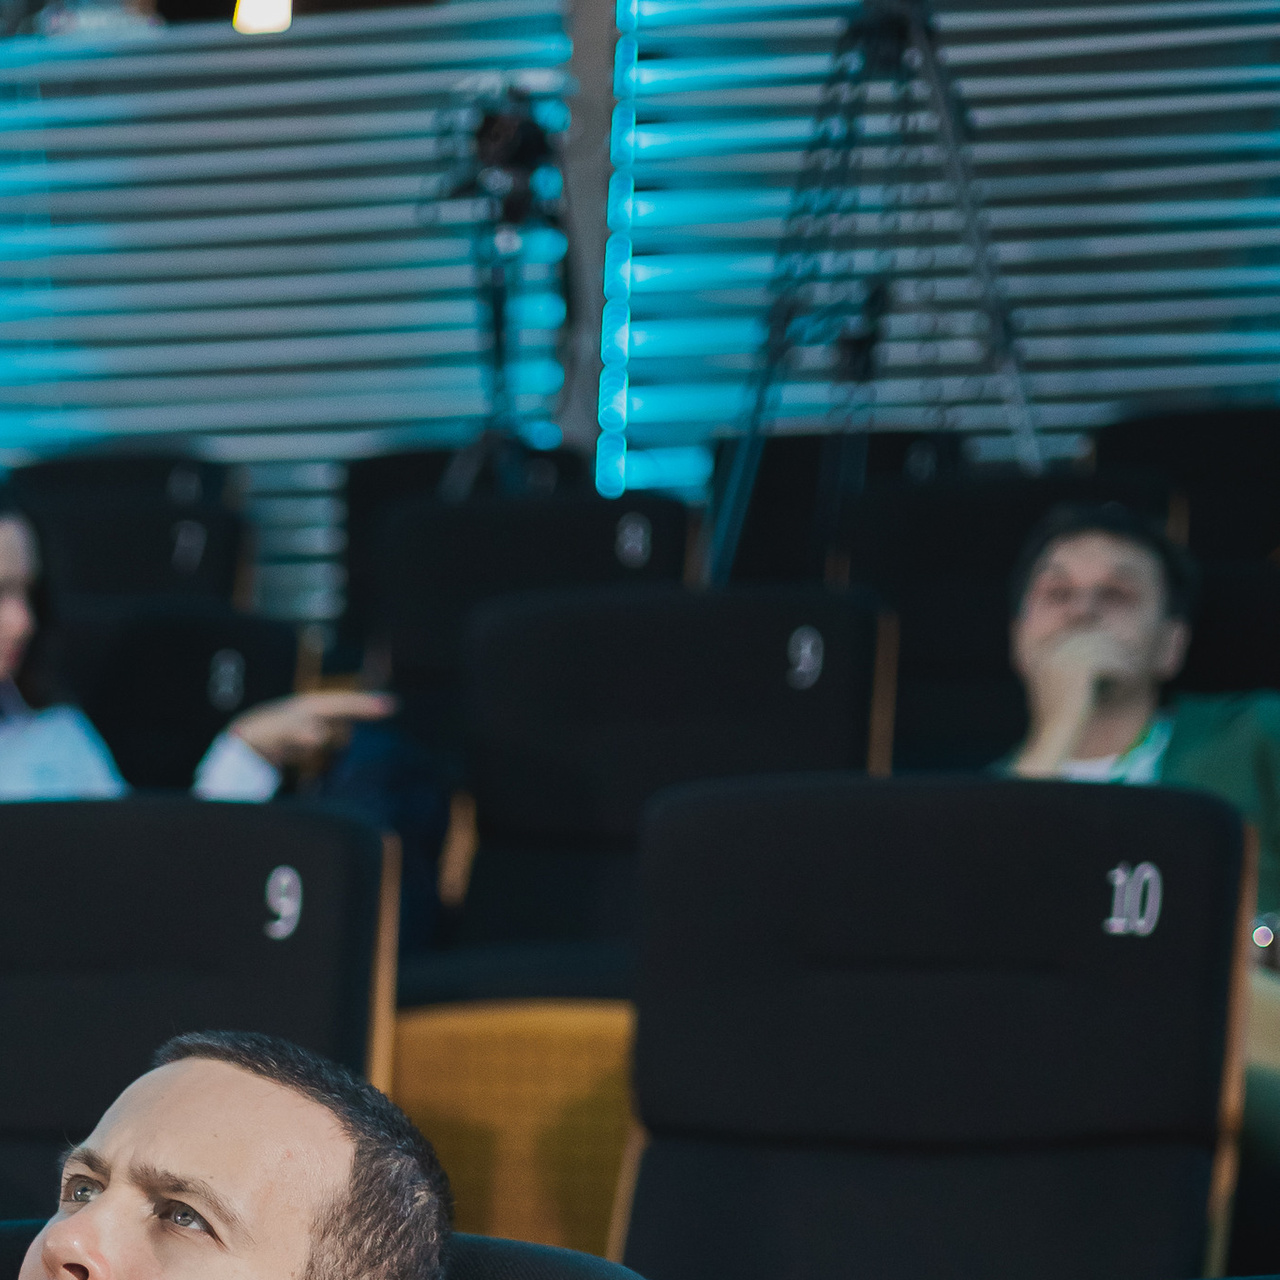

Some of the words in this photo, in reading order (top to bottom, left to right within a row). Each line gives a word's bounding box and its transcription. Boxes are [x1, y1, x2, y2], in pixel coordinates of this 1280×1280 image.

[787, 625, 824, 689] 9
[265, 865, 304, 940] 9
[1102, 861, 1164, 938] 10
